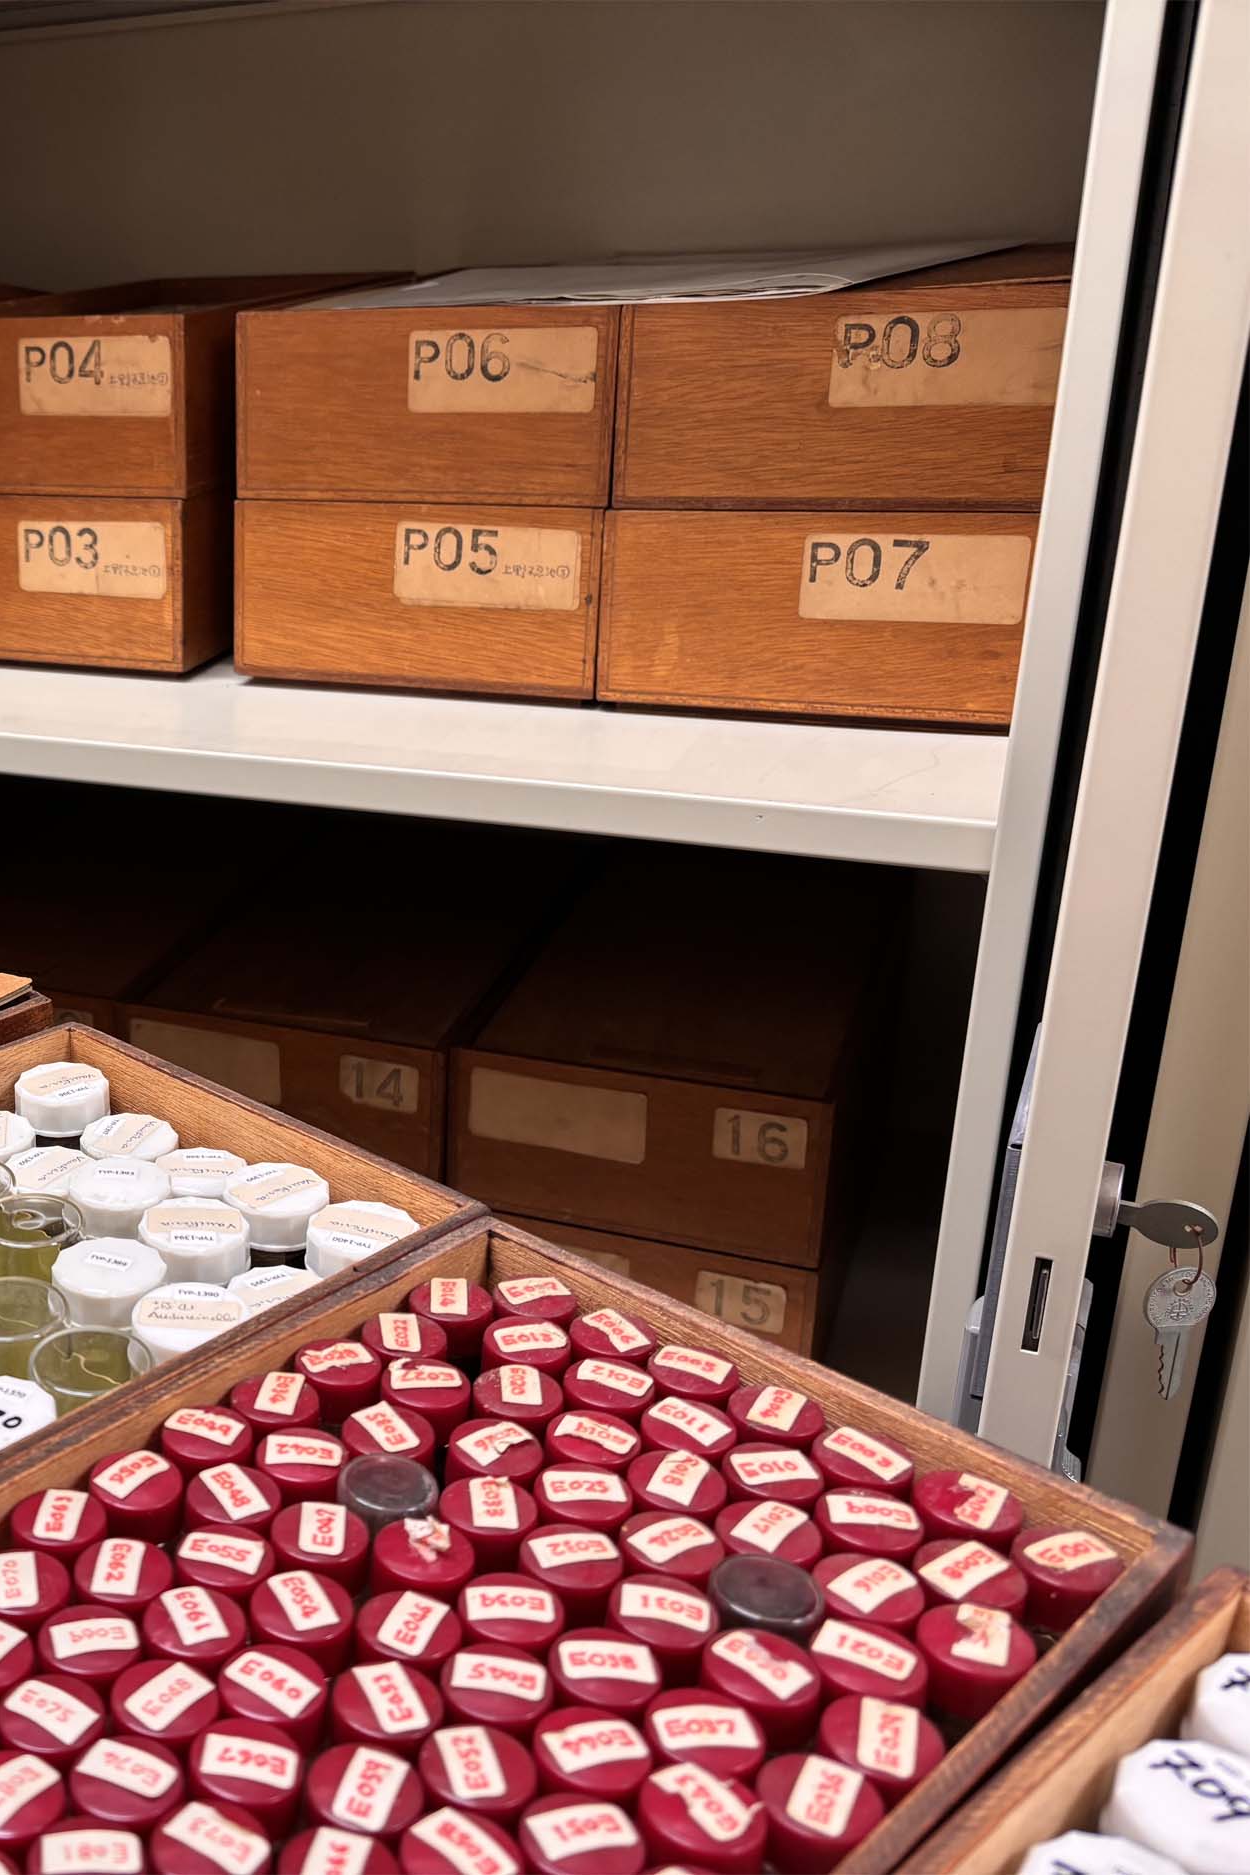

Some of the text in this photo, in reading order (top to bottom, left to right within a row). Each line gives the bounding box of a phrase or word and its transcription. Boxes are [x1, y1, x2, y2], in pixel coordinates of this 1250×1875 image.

[25, 339, 104, 385] P04
[414, 332, 510, 382] P06
[838, 313, 962, 369] P08
[24, 526, 99, 569] P03
[403, 526, 498, 575] P05
[808, 538, 930, 590] P07
[350, 1061, 405, 1107] 14
[727, 1113, 789, 1164] 16
[711, 1279, 771, 1326] 15
